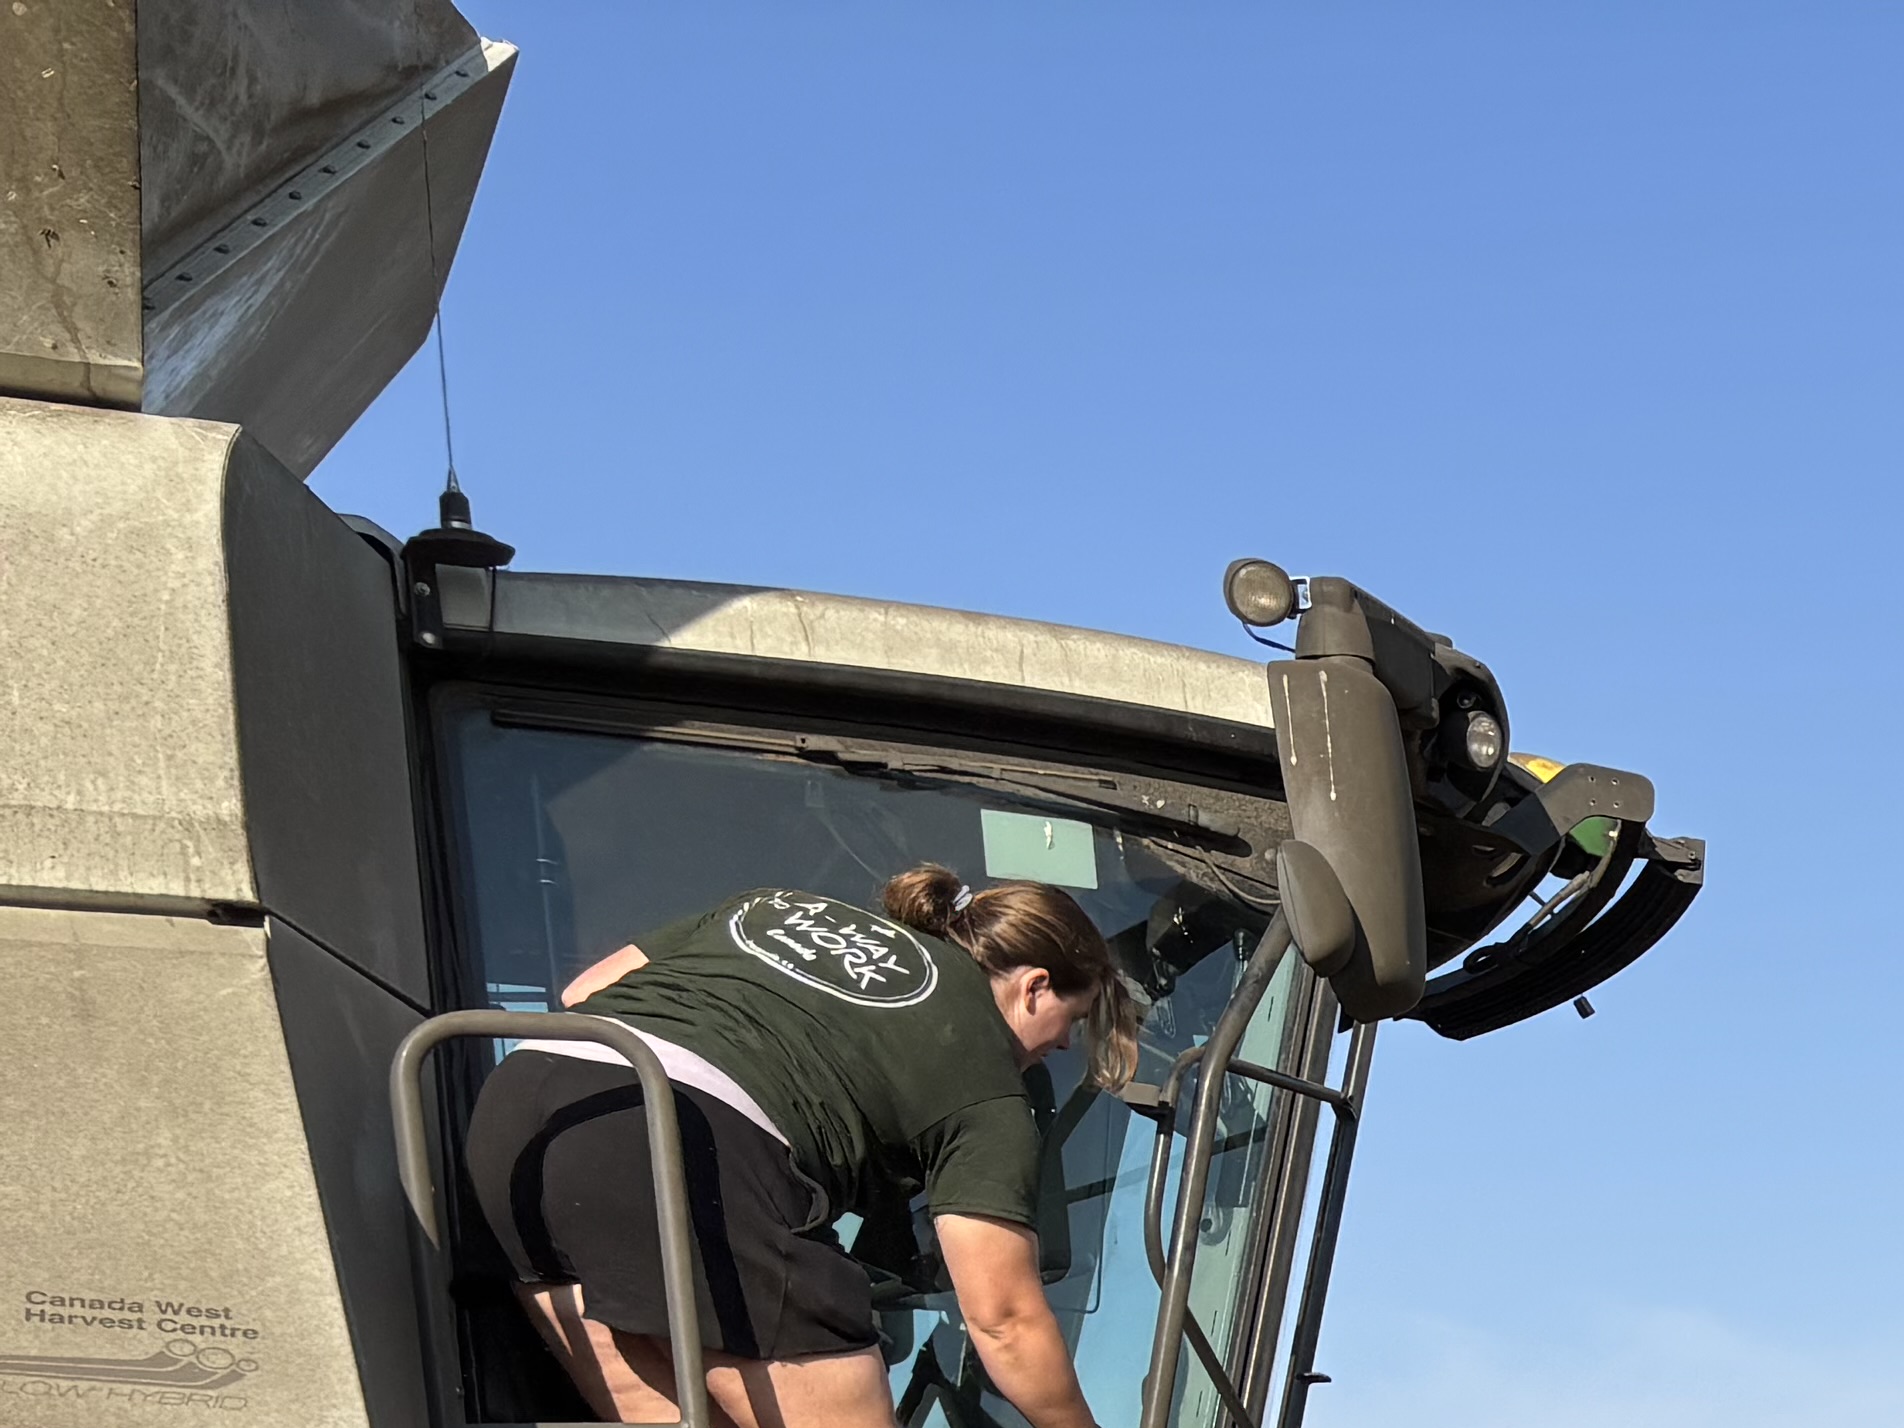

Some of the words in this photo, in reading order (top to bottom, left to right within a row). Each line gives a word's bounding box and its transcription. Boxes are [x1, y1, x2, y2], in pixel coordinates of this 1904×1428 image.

[784, 911, 887, 990] WORK
[24, 1290, 145, 1314] Canada
[155, 1300, 234, 1320] West
[24, 1308, 147, 1331] Harvest
[156, 1318, 260, 1340] Centre
[106, 1386, 249, 1411] HYBRID
